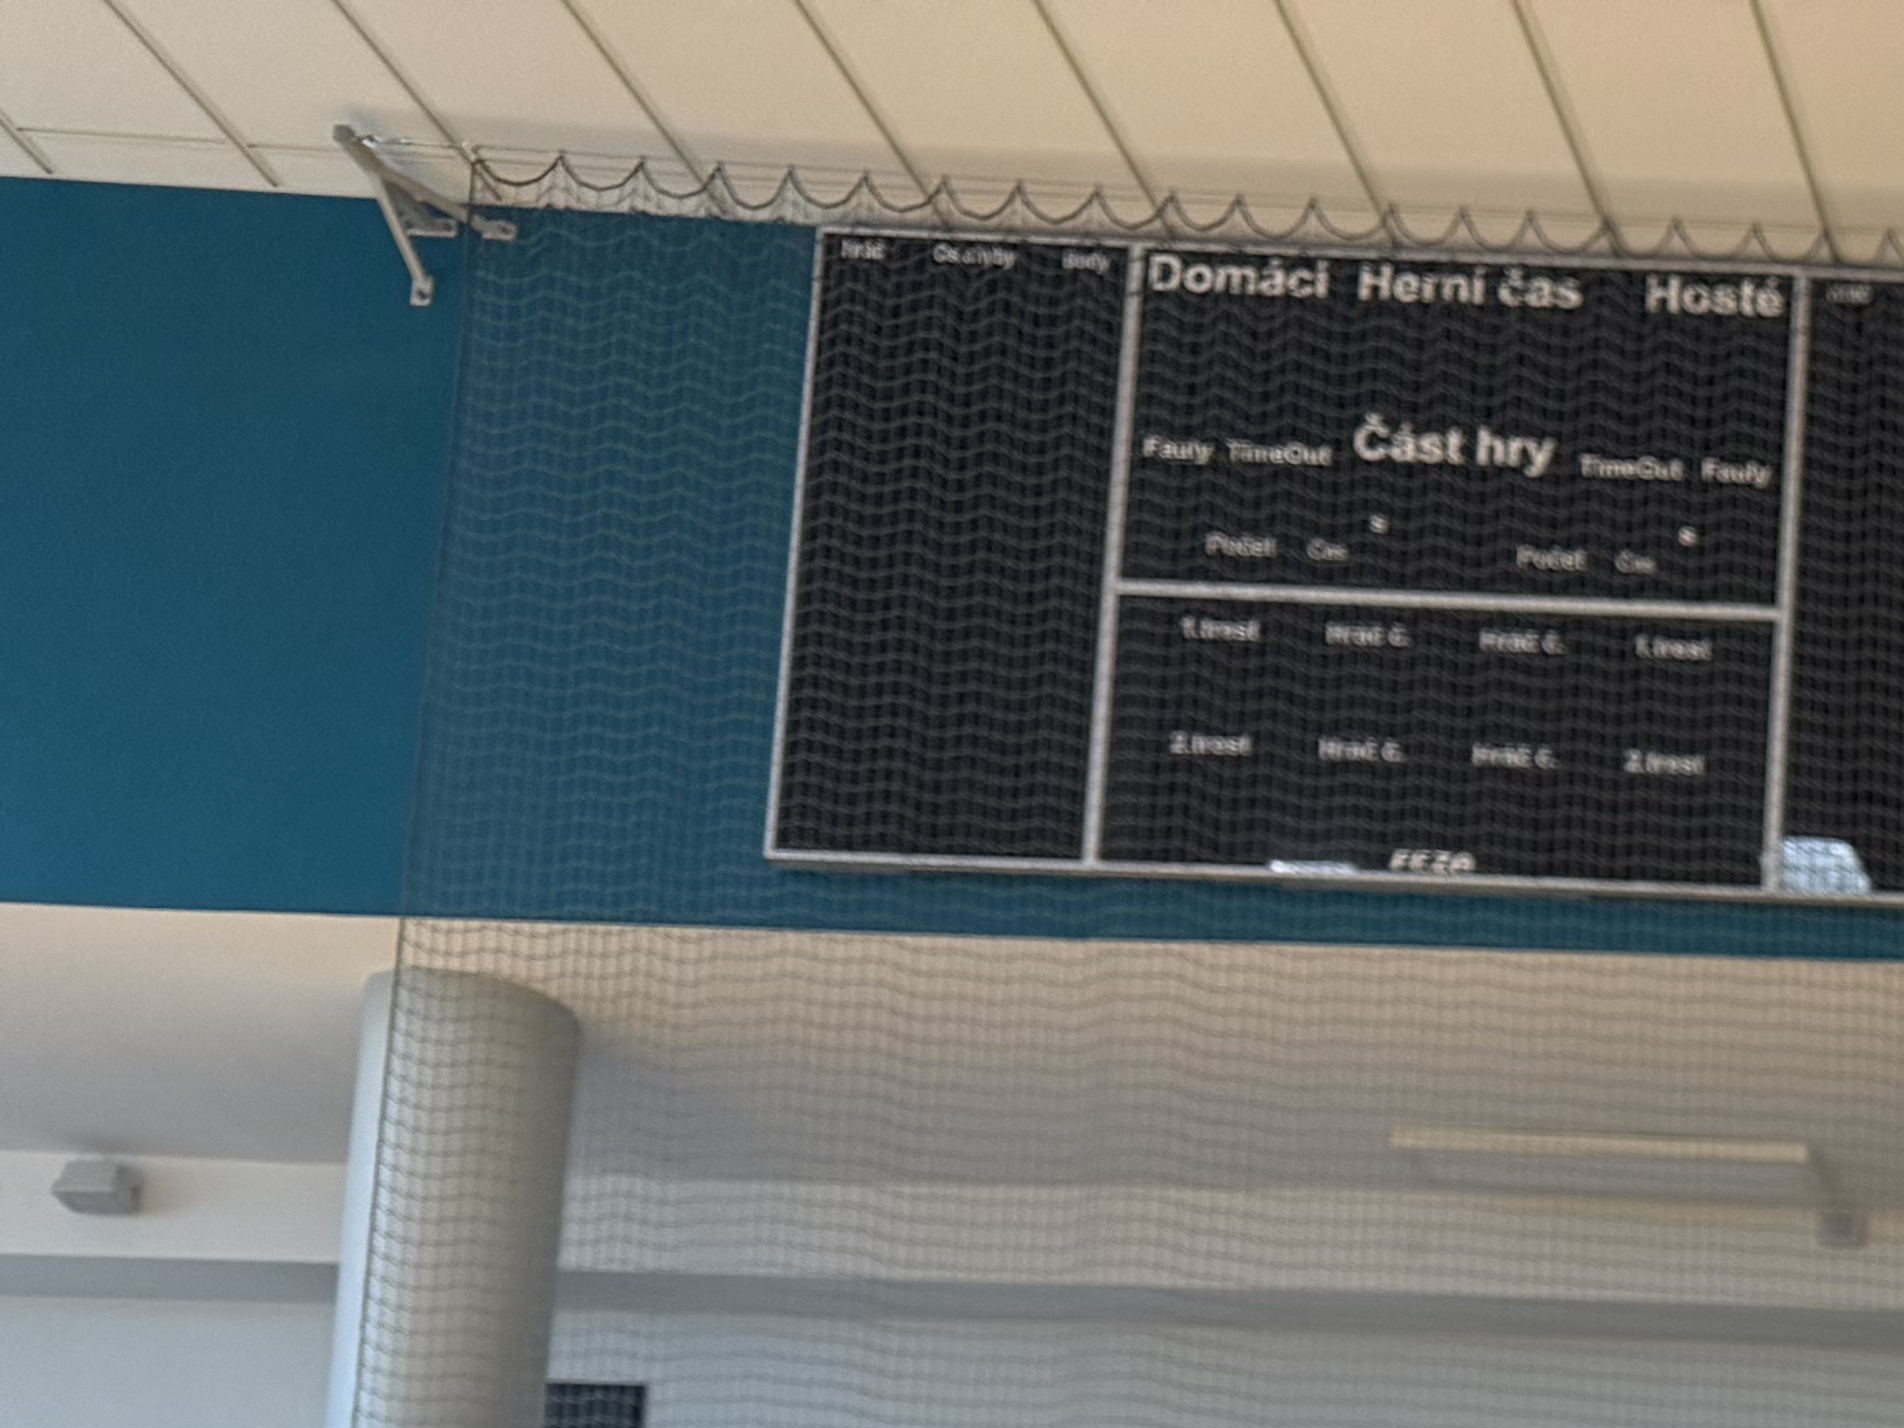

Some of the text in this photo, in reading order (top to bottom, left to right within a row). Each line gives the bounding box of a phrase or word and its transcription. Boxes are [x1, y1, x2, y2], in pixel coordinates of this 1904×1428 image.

[1147, 253, 1330, 300] Domácí
[1356, 263, 1584, 310] Herní čas
[1645, 274, 1785, 318] Hosté
[1353, 413, 1556, 479] Část hry
